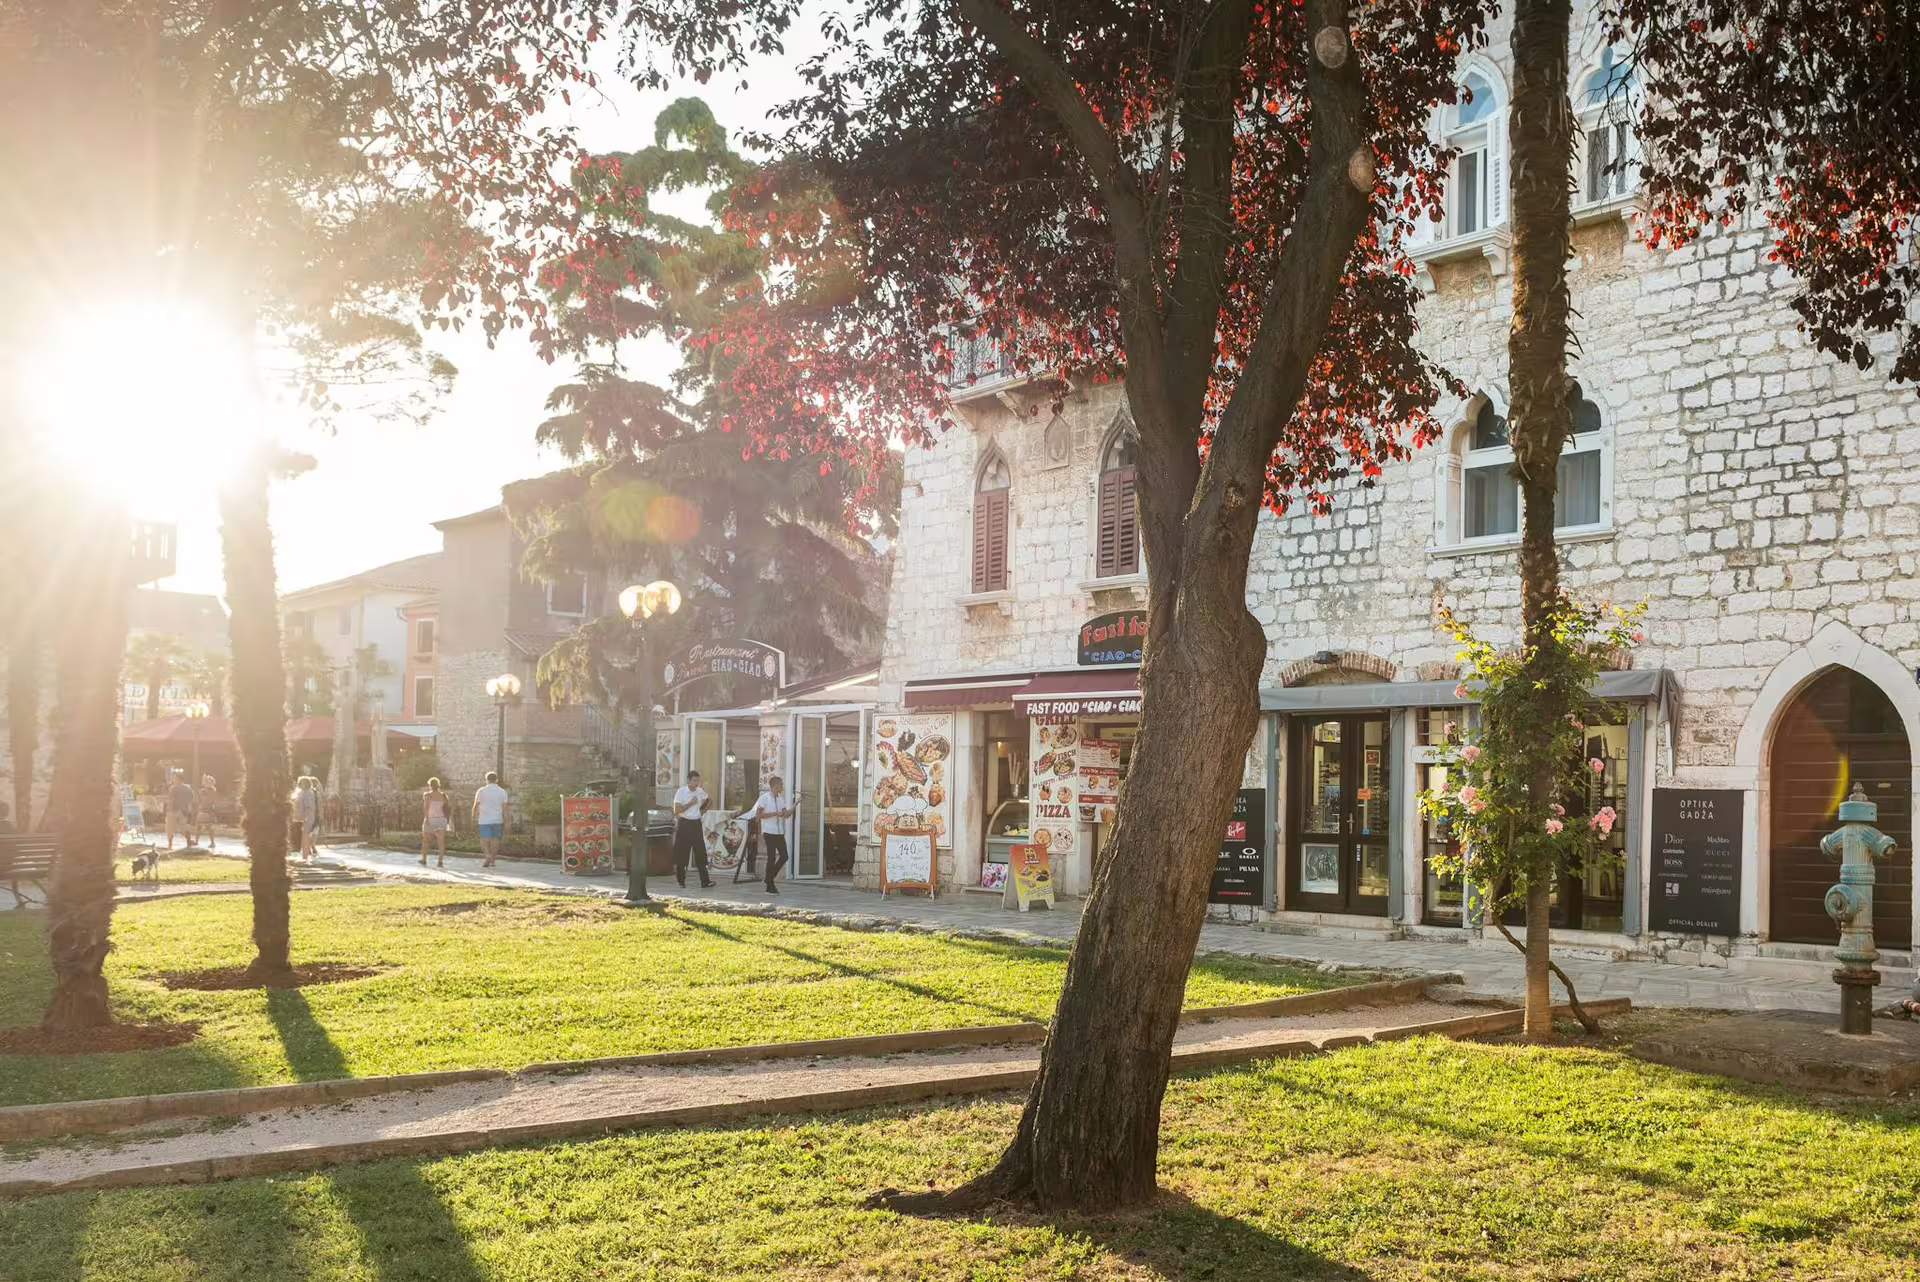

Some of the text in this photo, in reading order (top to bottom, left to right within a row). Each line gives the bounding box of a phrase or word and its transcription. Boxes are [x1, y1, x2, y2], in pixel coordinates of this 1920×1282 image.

[1082, 615, 1148, 647] Fast fo
[689, 644, 759, 664] Restaurant
[1026, 703, 1050, 714] FAST
[1052, 702, 1080, 713] FOOD
[1233, 804, 1247, 813] DŽA
[1680, 800, 1714, 809] OPTIKA
[1036, 804, 1071, 818] PIZZA
[1680, 810, 1714, 820] GADŽA
[1664, 833, 1684, 845] Dior
[1664, 858, 1683, 866] BOSS
[1238, 865, 1260, 873] PRADA
[1668, 918, 1718, 929] OFFICIAL DEALER
